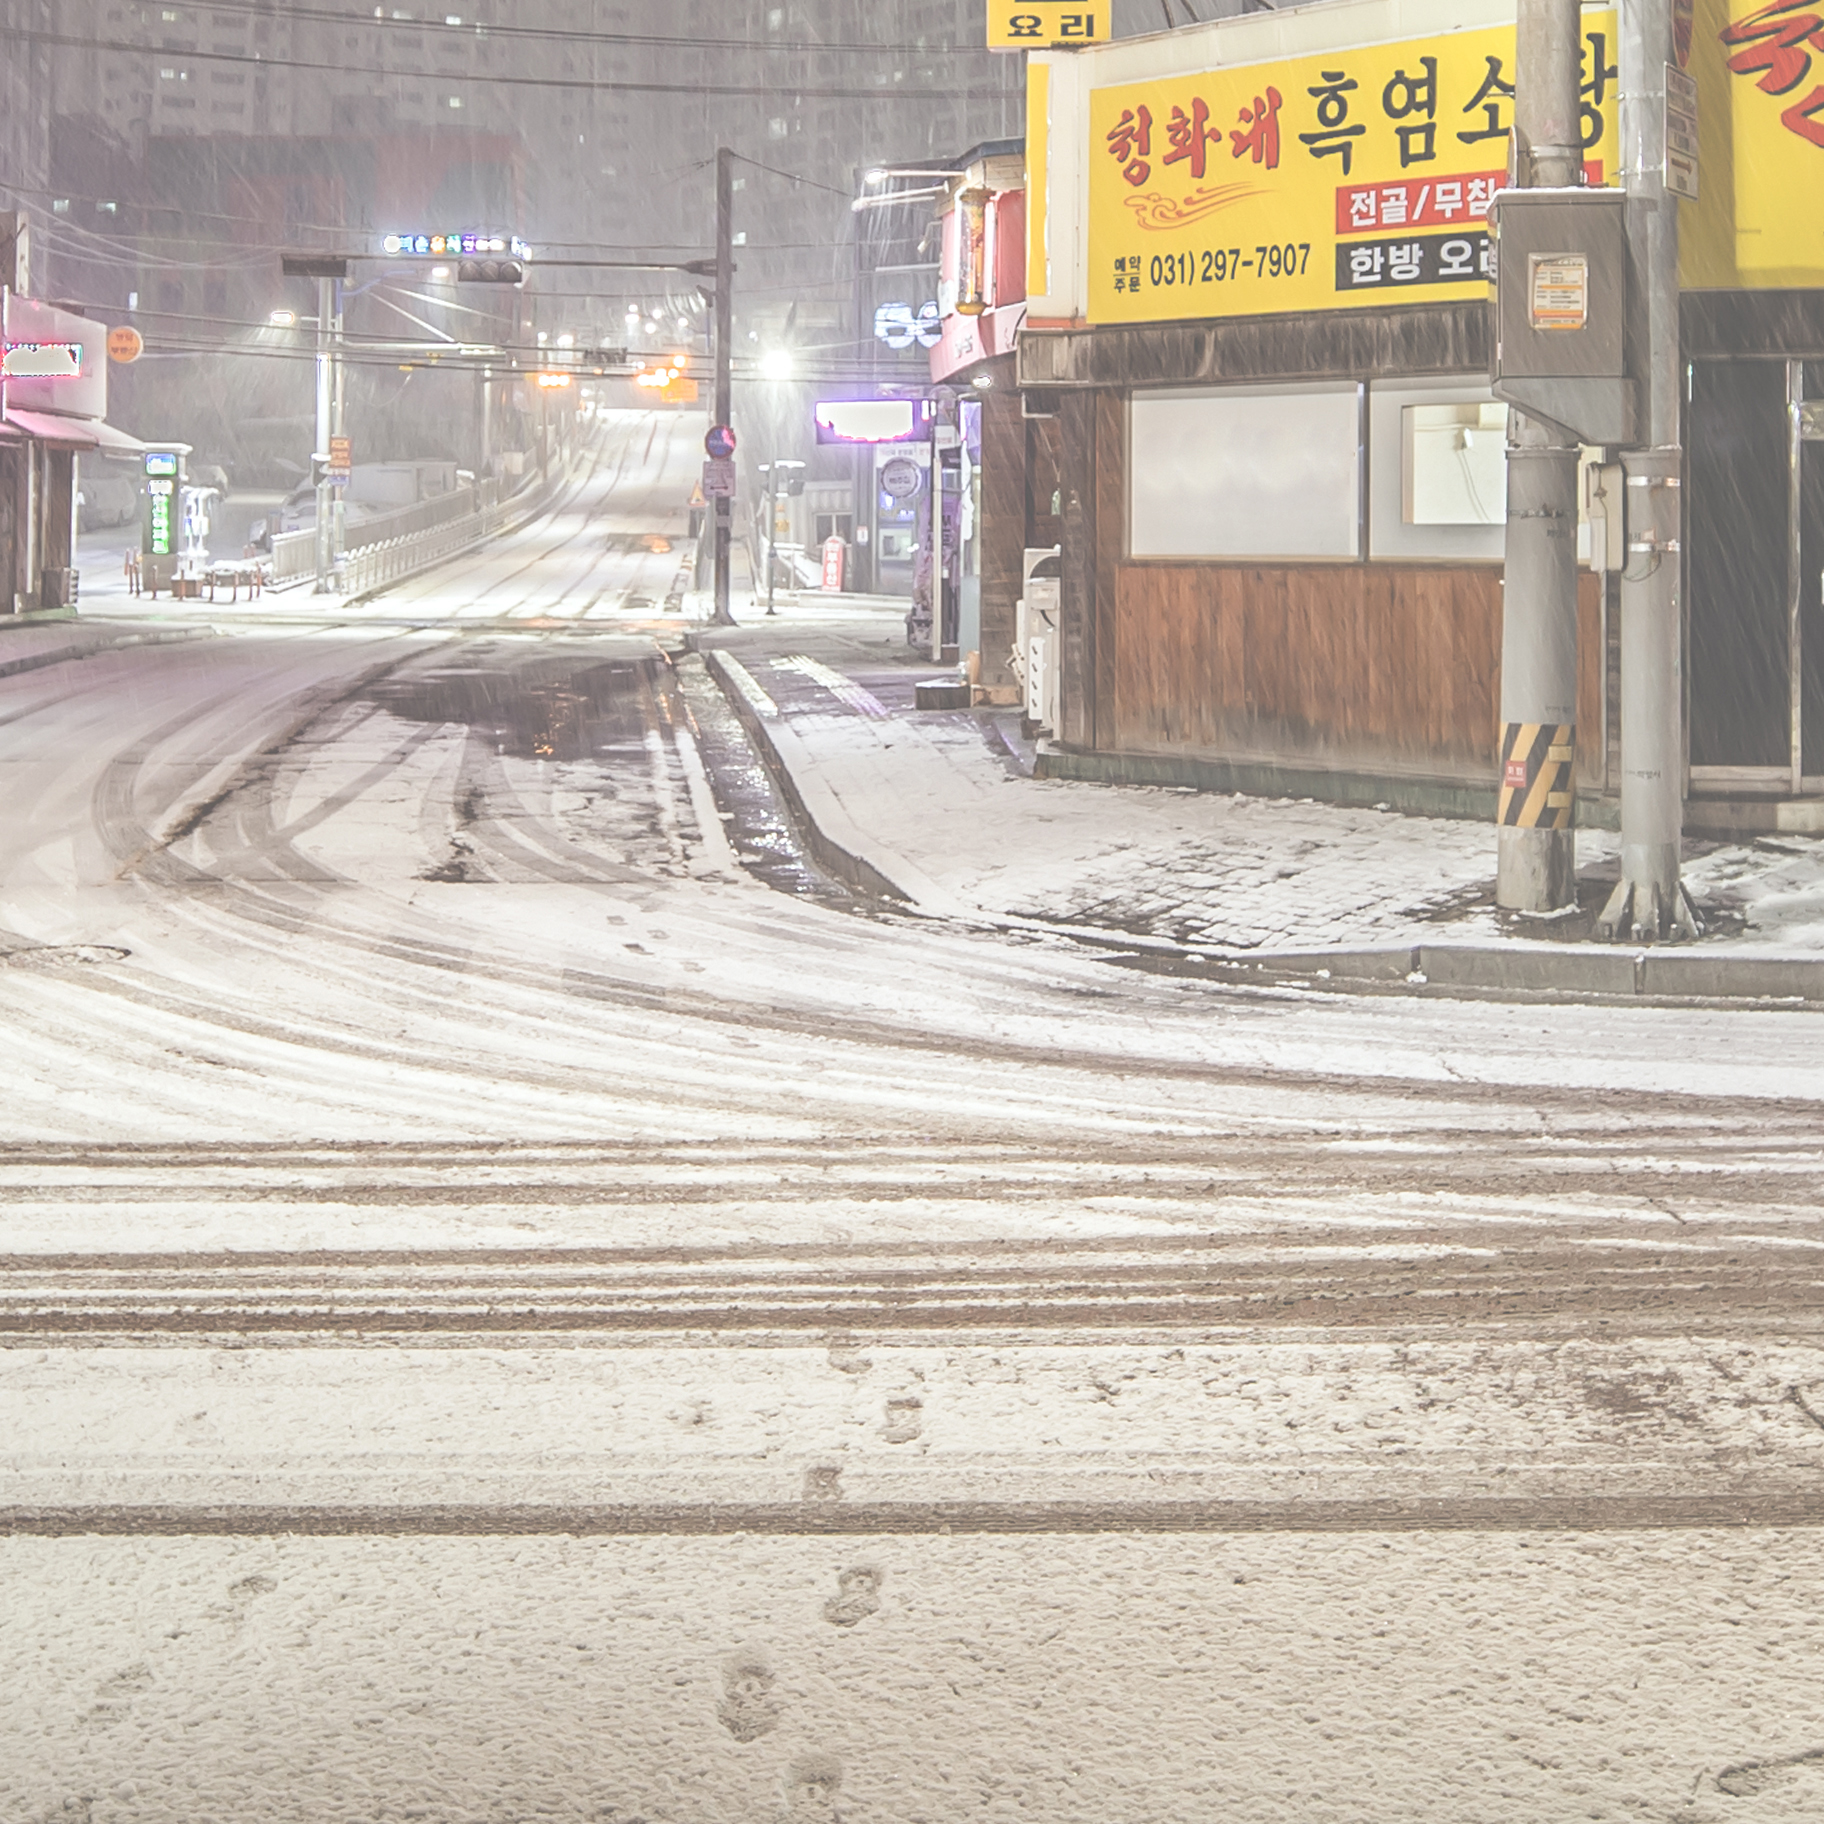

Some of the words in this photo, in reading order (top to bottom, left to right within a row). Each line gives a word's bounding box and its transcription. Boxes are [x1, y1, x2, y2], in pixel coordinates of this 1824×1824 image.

[1006, 14, 1096, 38] 요리
[1106, 84, 1284, 188] 청화대
[1114, 257, 1142, 273] 예약
[1149, 253, 1196, 290] 031)
[1200, 242, 1312, 283] 297-7907
[1349, 241, 1424, 286] 한방
[1114, 277, 1142, 294] 주문
